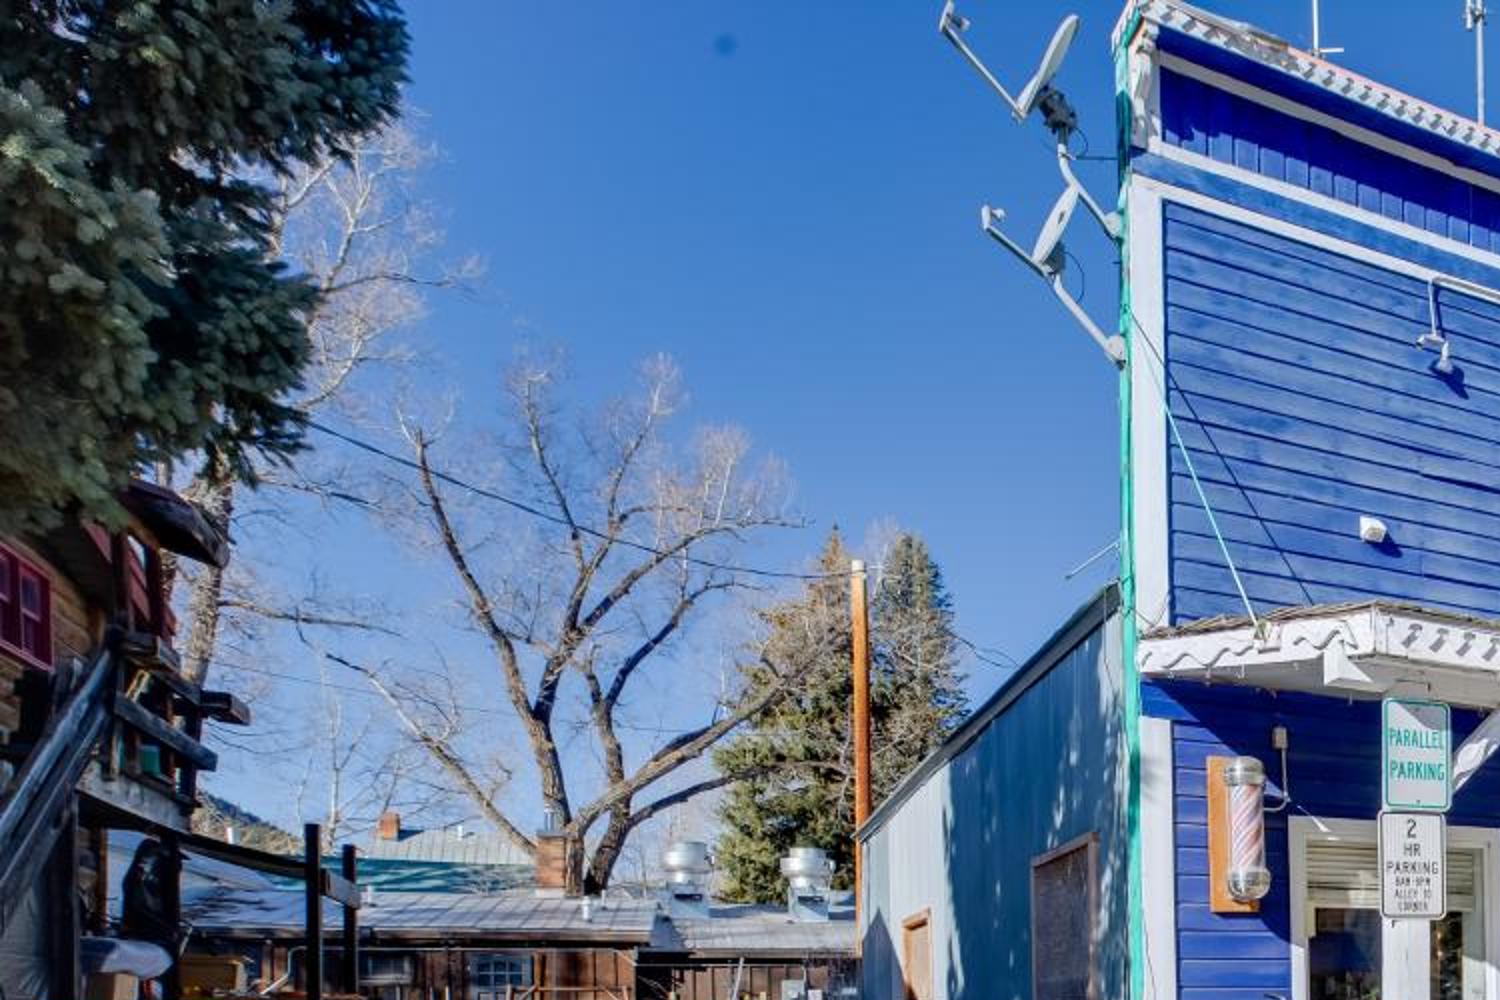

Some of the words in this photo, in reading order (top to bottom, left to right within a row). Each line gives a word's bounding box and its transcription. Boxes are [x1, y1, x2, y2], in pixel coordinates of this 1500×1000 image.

[1389, 728, 1443, 749] PARALLEL
[1391, 760, 1444, 781] PARKING
[1407, 818, 1417, 839] 2
[1403, 843, 1421, 857] HR
[1386, 861, 1439, 875] PARKING
